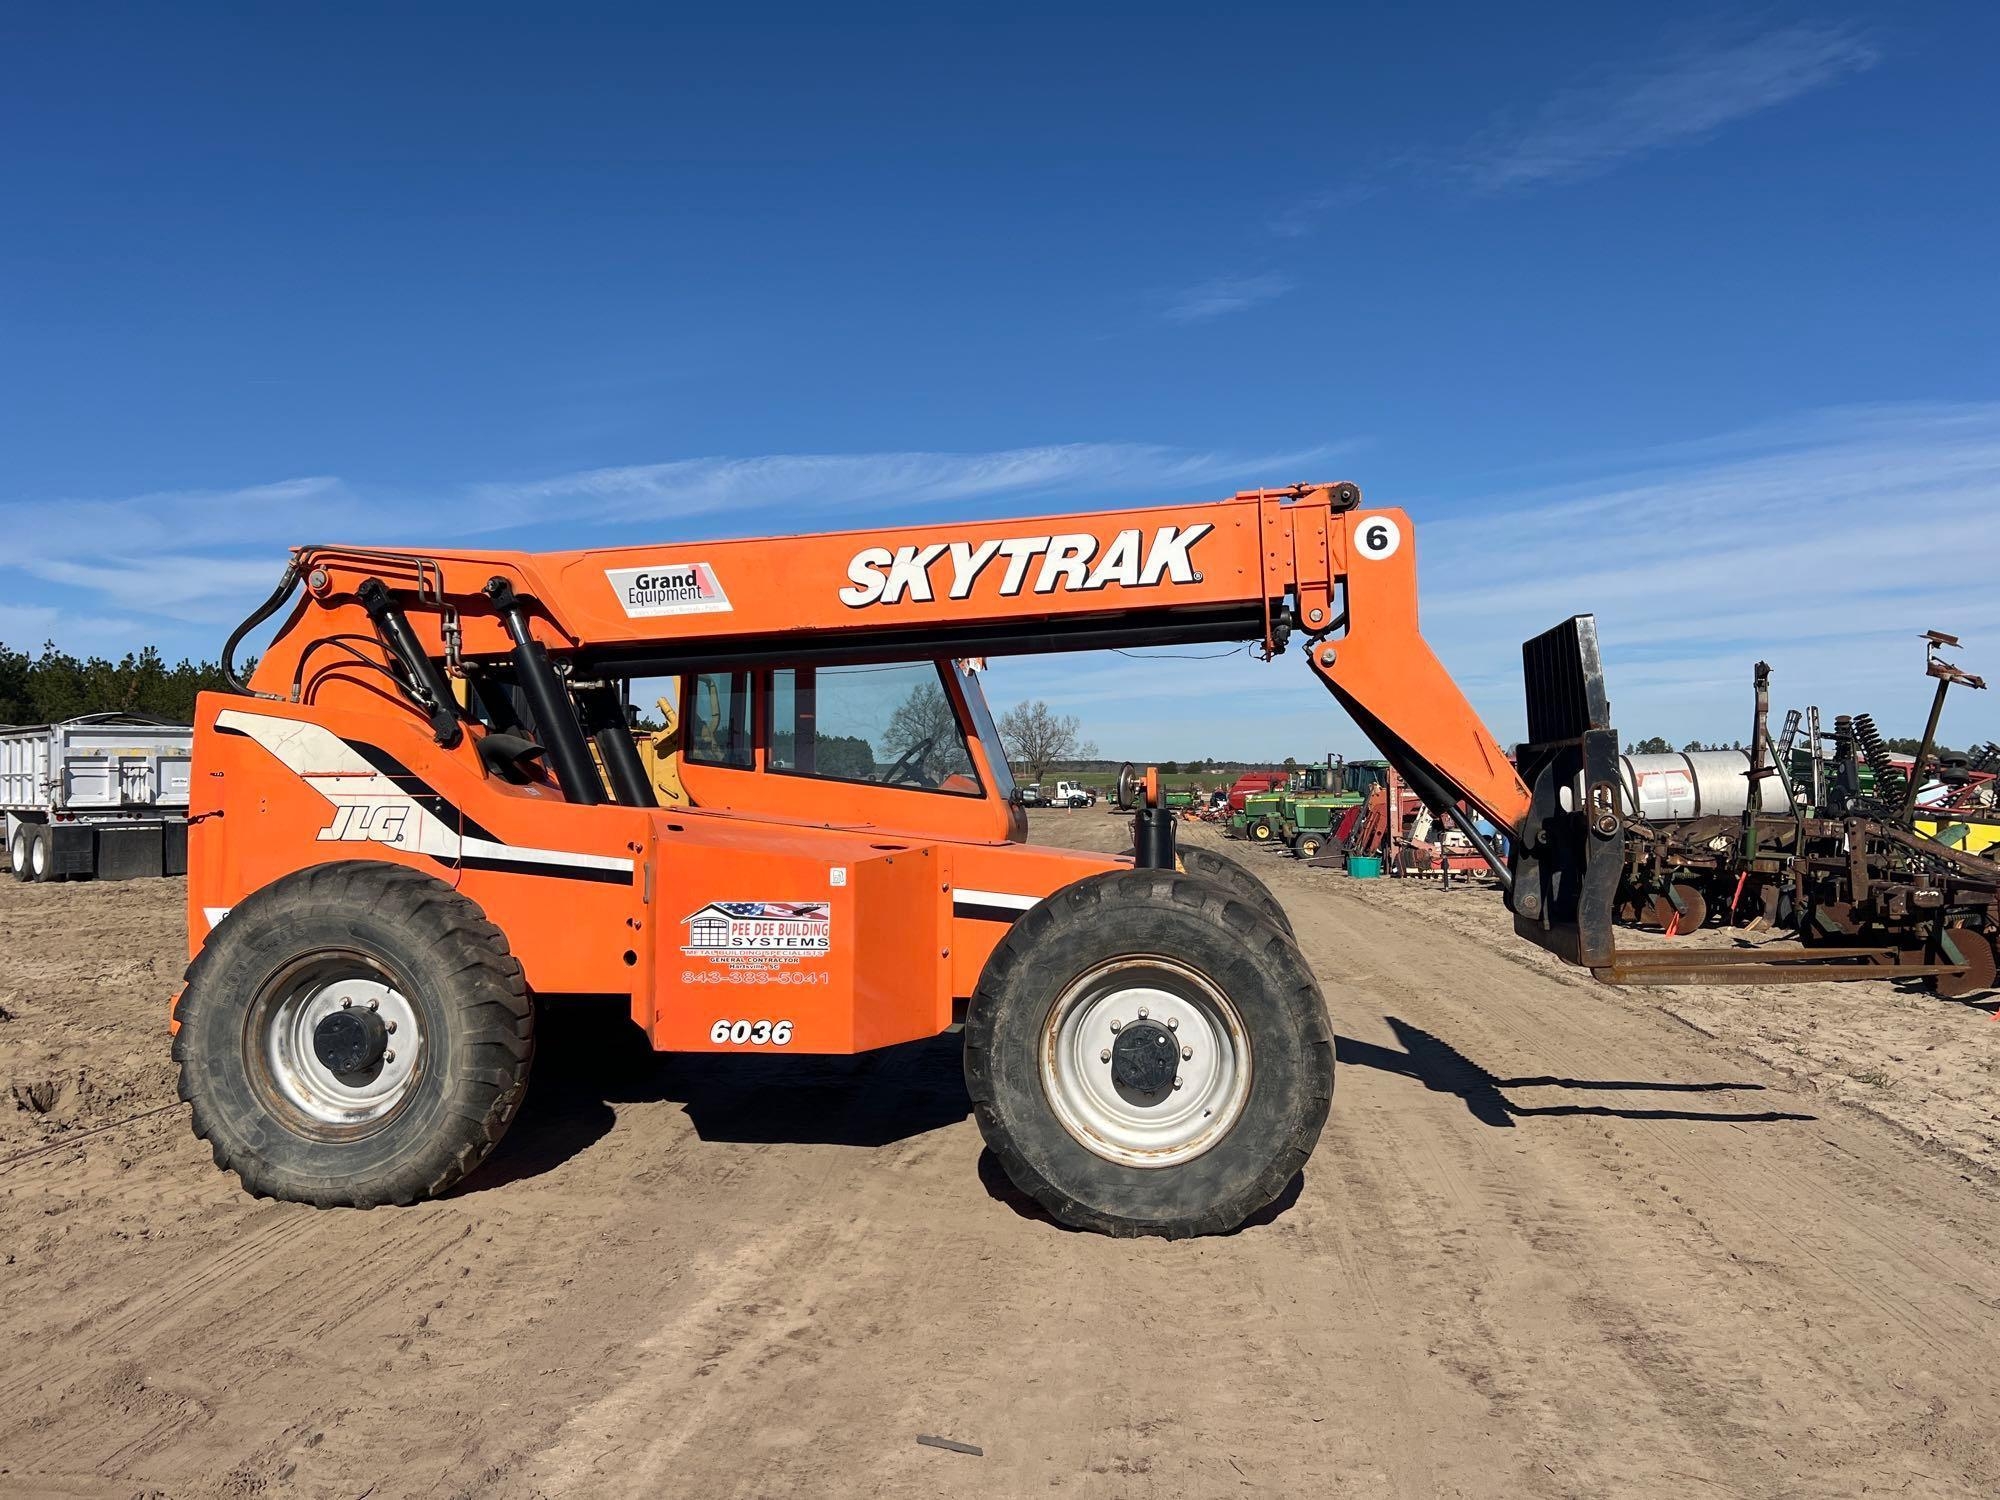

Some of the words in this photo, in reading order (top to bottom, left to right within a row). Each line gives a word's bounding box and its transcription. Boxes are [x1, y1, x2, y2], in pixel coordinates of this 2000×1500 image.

[1366, 525, 1388, 550] 6
[838, 523, 1215, 609] SKYTRAK
[635, 569, 697, 590] Grand
[628, 584, 702, 606] Equipment
[315, 805, 410, 842] JLG
[732, 923, 750, 936] PEE
[754, 923, 775, 936] DEE
[778, 923, 828, 936] BUILDING
[732, 937, 828, 946] SYSTEMS
[682, 971, 829, 984] 843-383-5041
[710, 1019, 794, 1046] 6036
